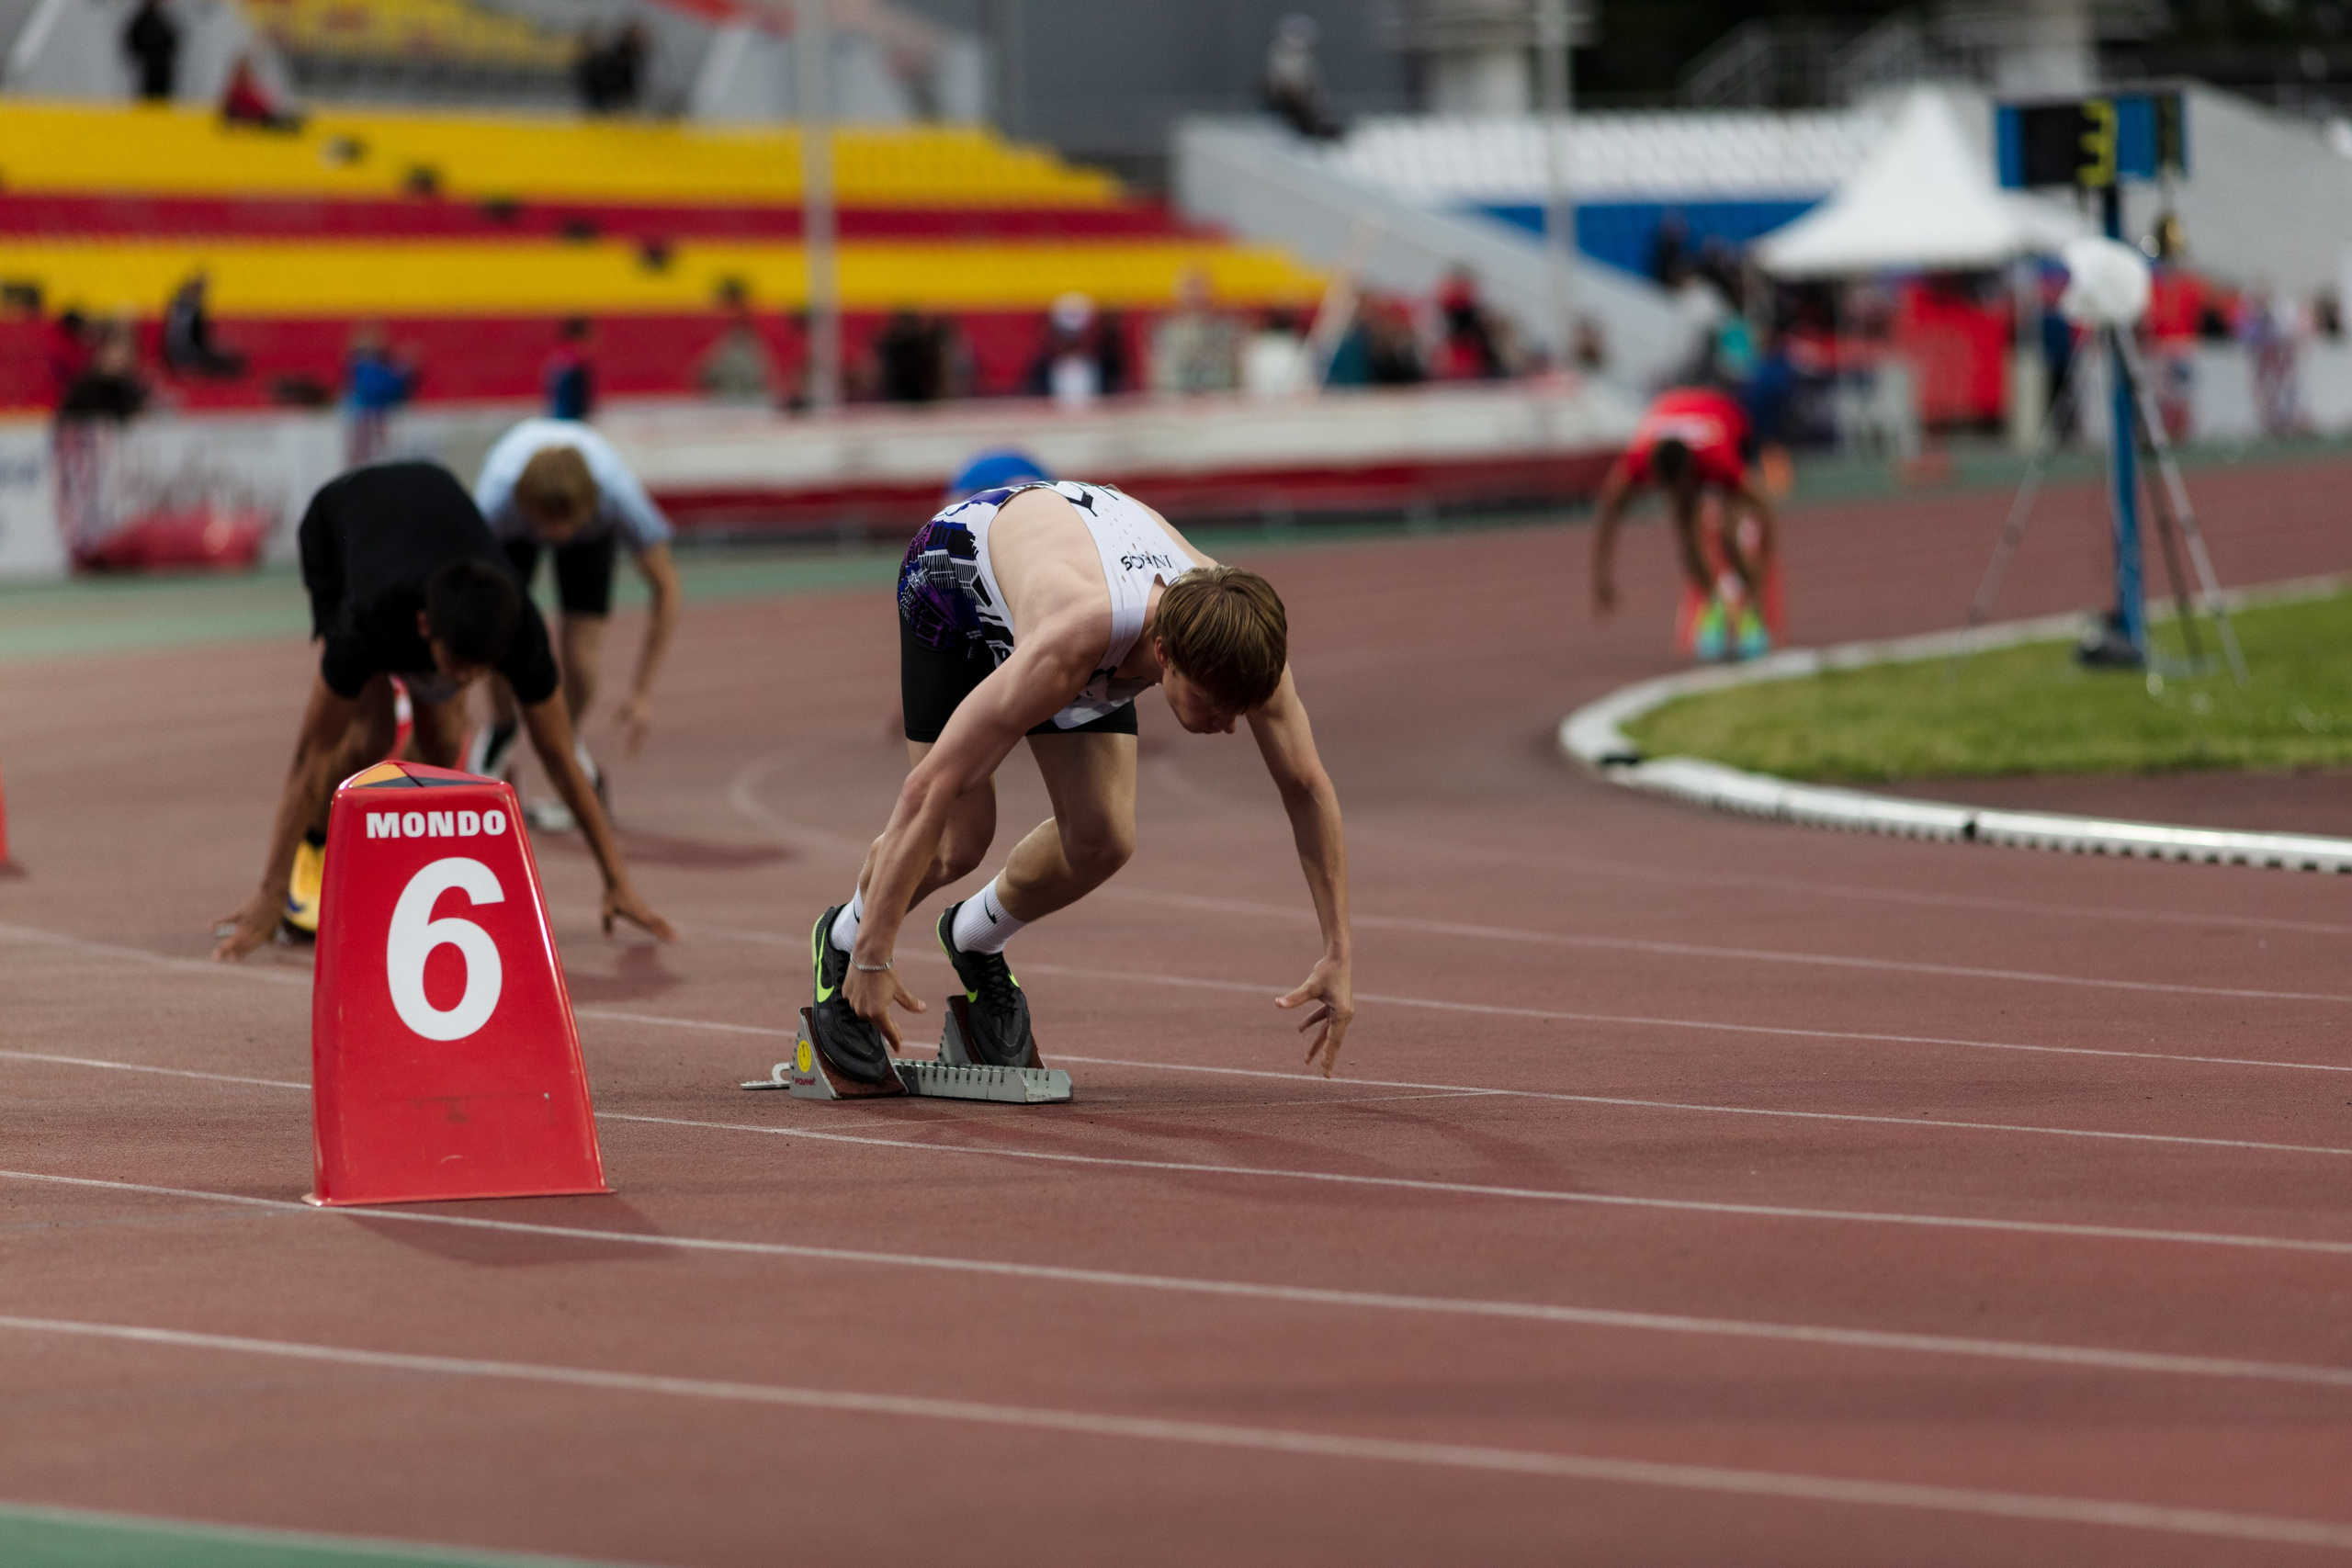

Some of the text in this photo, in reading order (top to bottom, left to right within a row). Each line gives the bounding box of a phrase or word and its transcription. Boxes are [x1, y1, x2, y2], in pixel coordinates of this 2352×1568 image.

[2076, 98, 2119, 186] 3
[366, 809, 507, 839] MONDO
[387, 856, 505, 1042] 6
